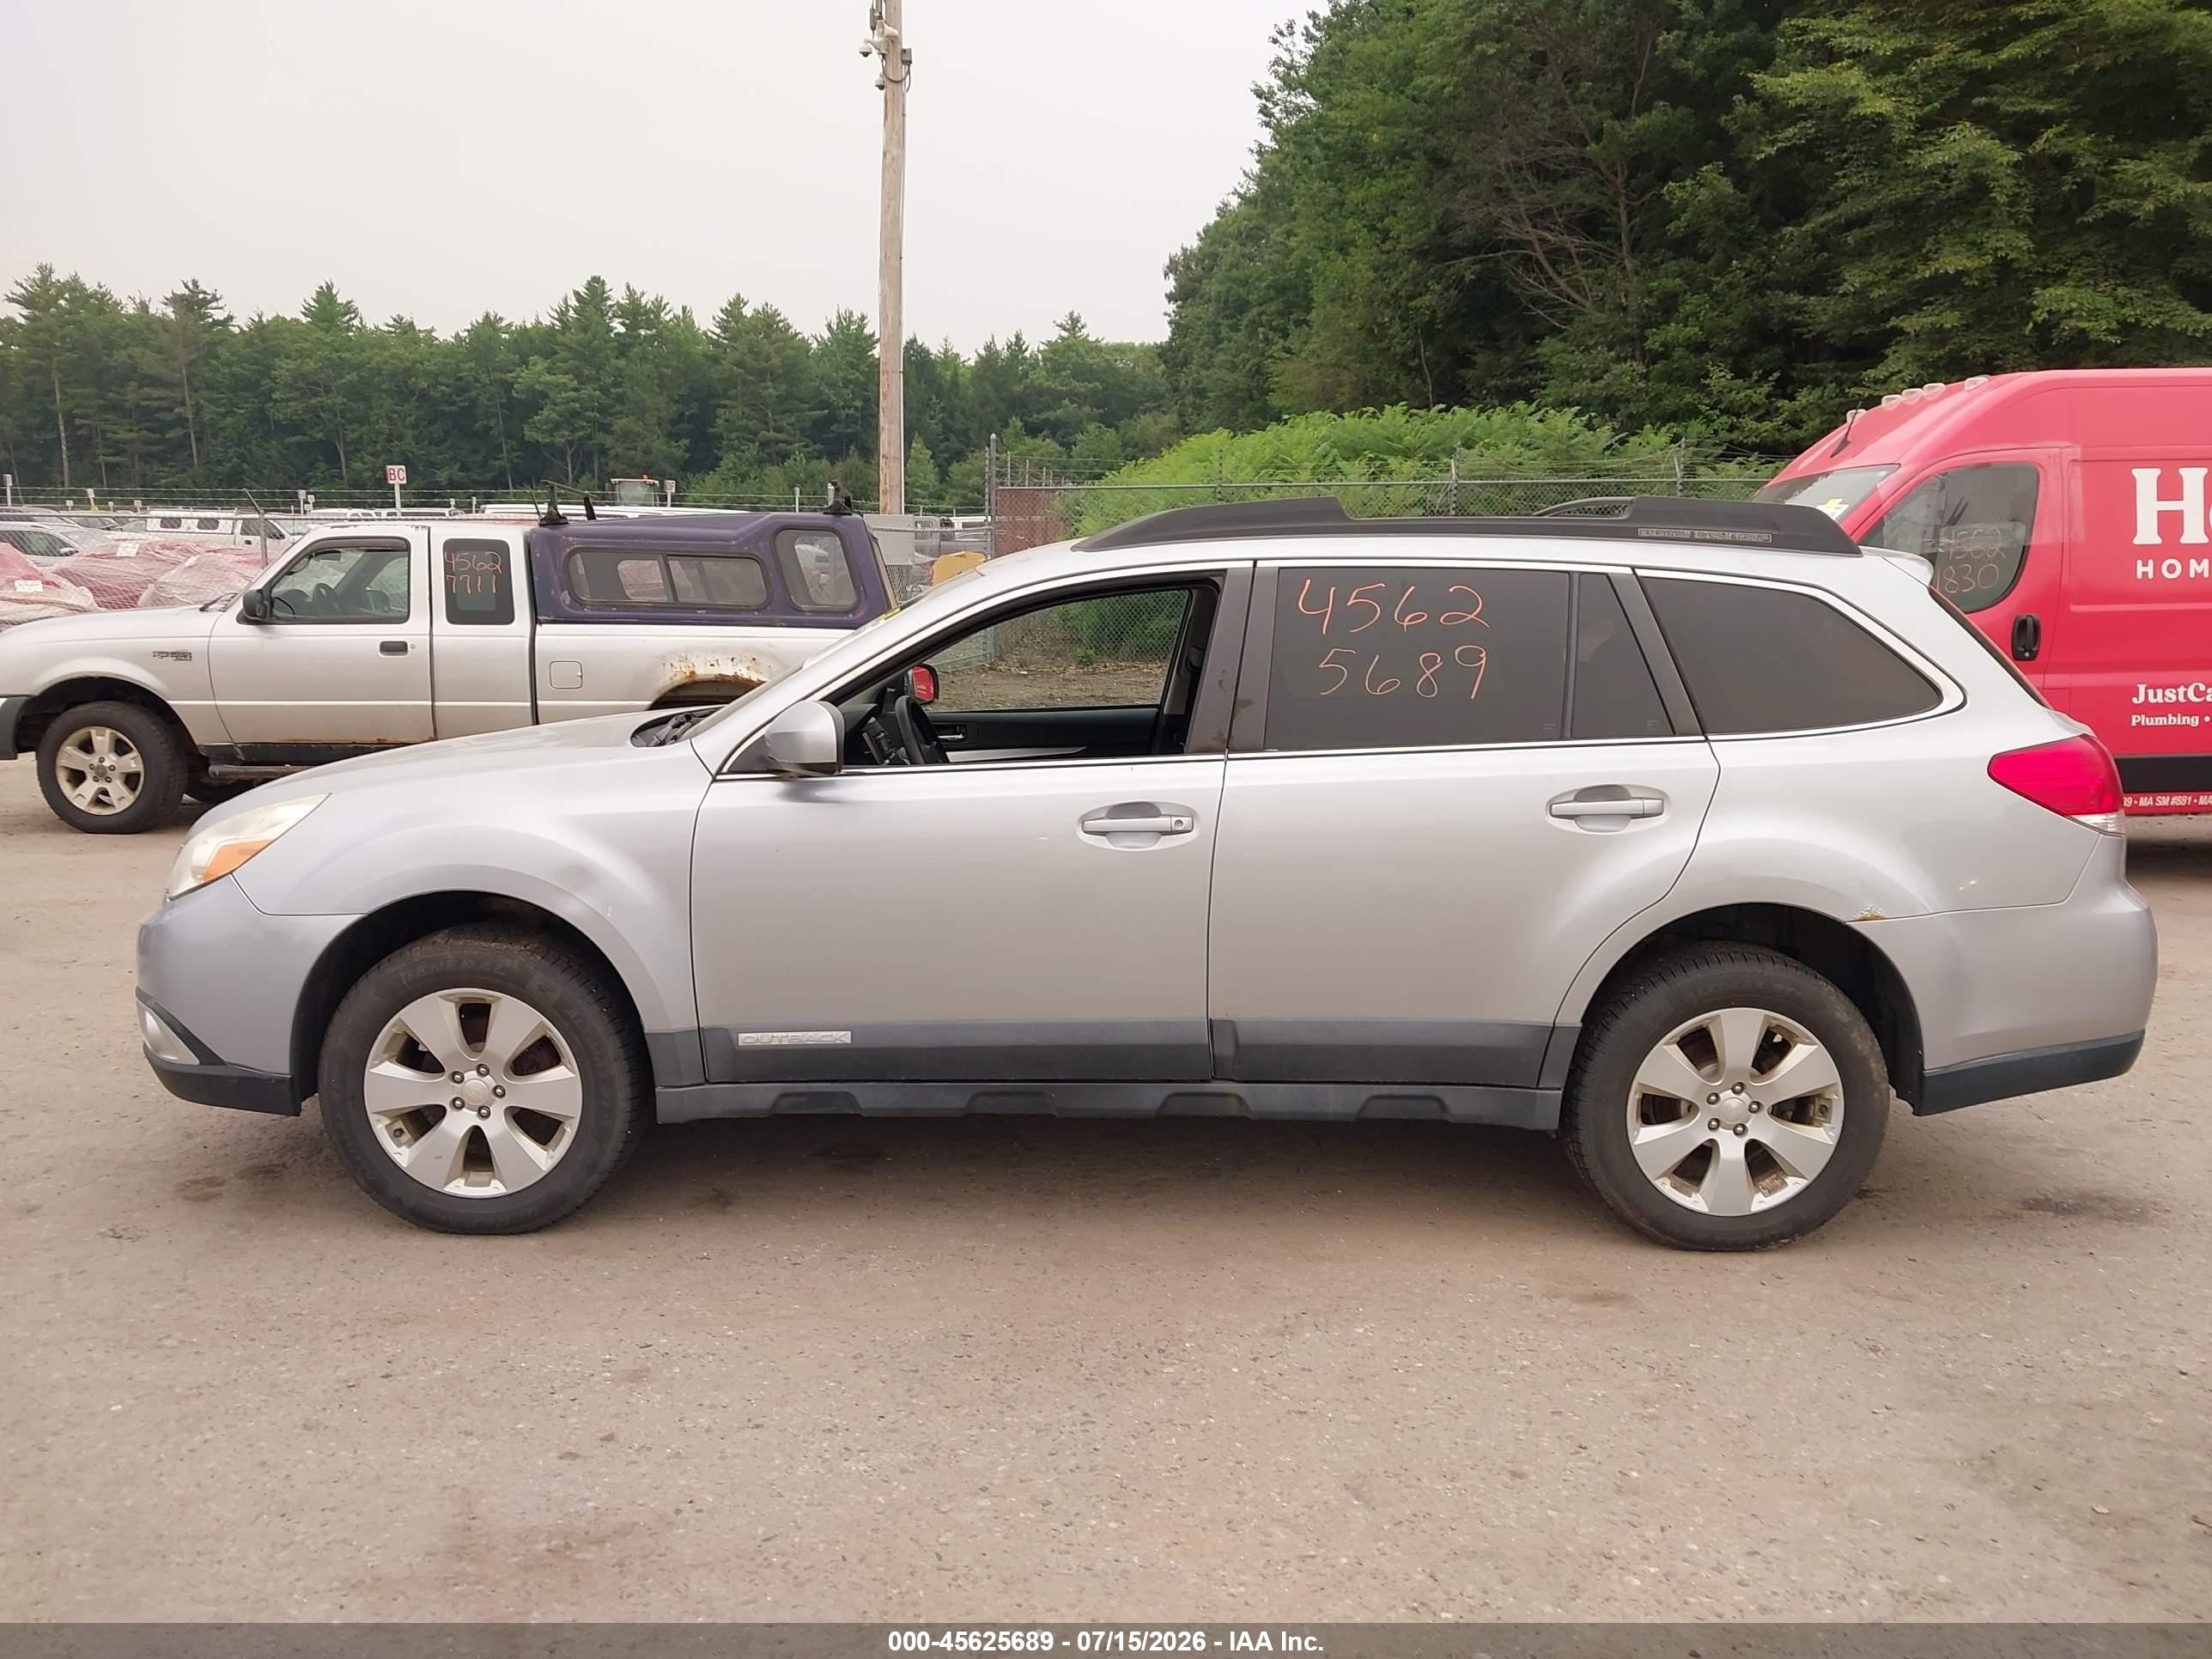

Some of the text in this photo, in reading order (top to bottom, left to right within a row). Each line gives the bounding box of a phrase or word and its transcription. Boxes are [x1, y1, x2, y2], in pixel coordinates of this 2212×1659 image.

[389, 468, 404, 481] BC
[2131, 467, 2212, 544] H
[444, 551, 501, 574] 4562
[2136, 557, 2209, 580] HOM
[446, 574, 496, 594] 7711
[1297, 579, 1491, 635] 4562
[1318, 645, 1486, 699] 5689
[2130, 714, 2200, 727] Plumbing
[2138, 796, 2154, 806] MA
[2155, 795, 2170, 806] SM
[741, 1032, 850, 1045] OUTBACK
